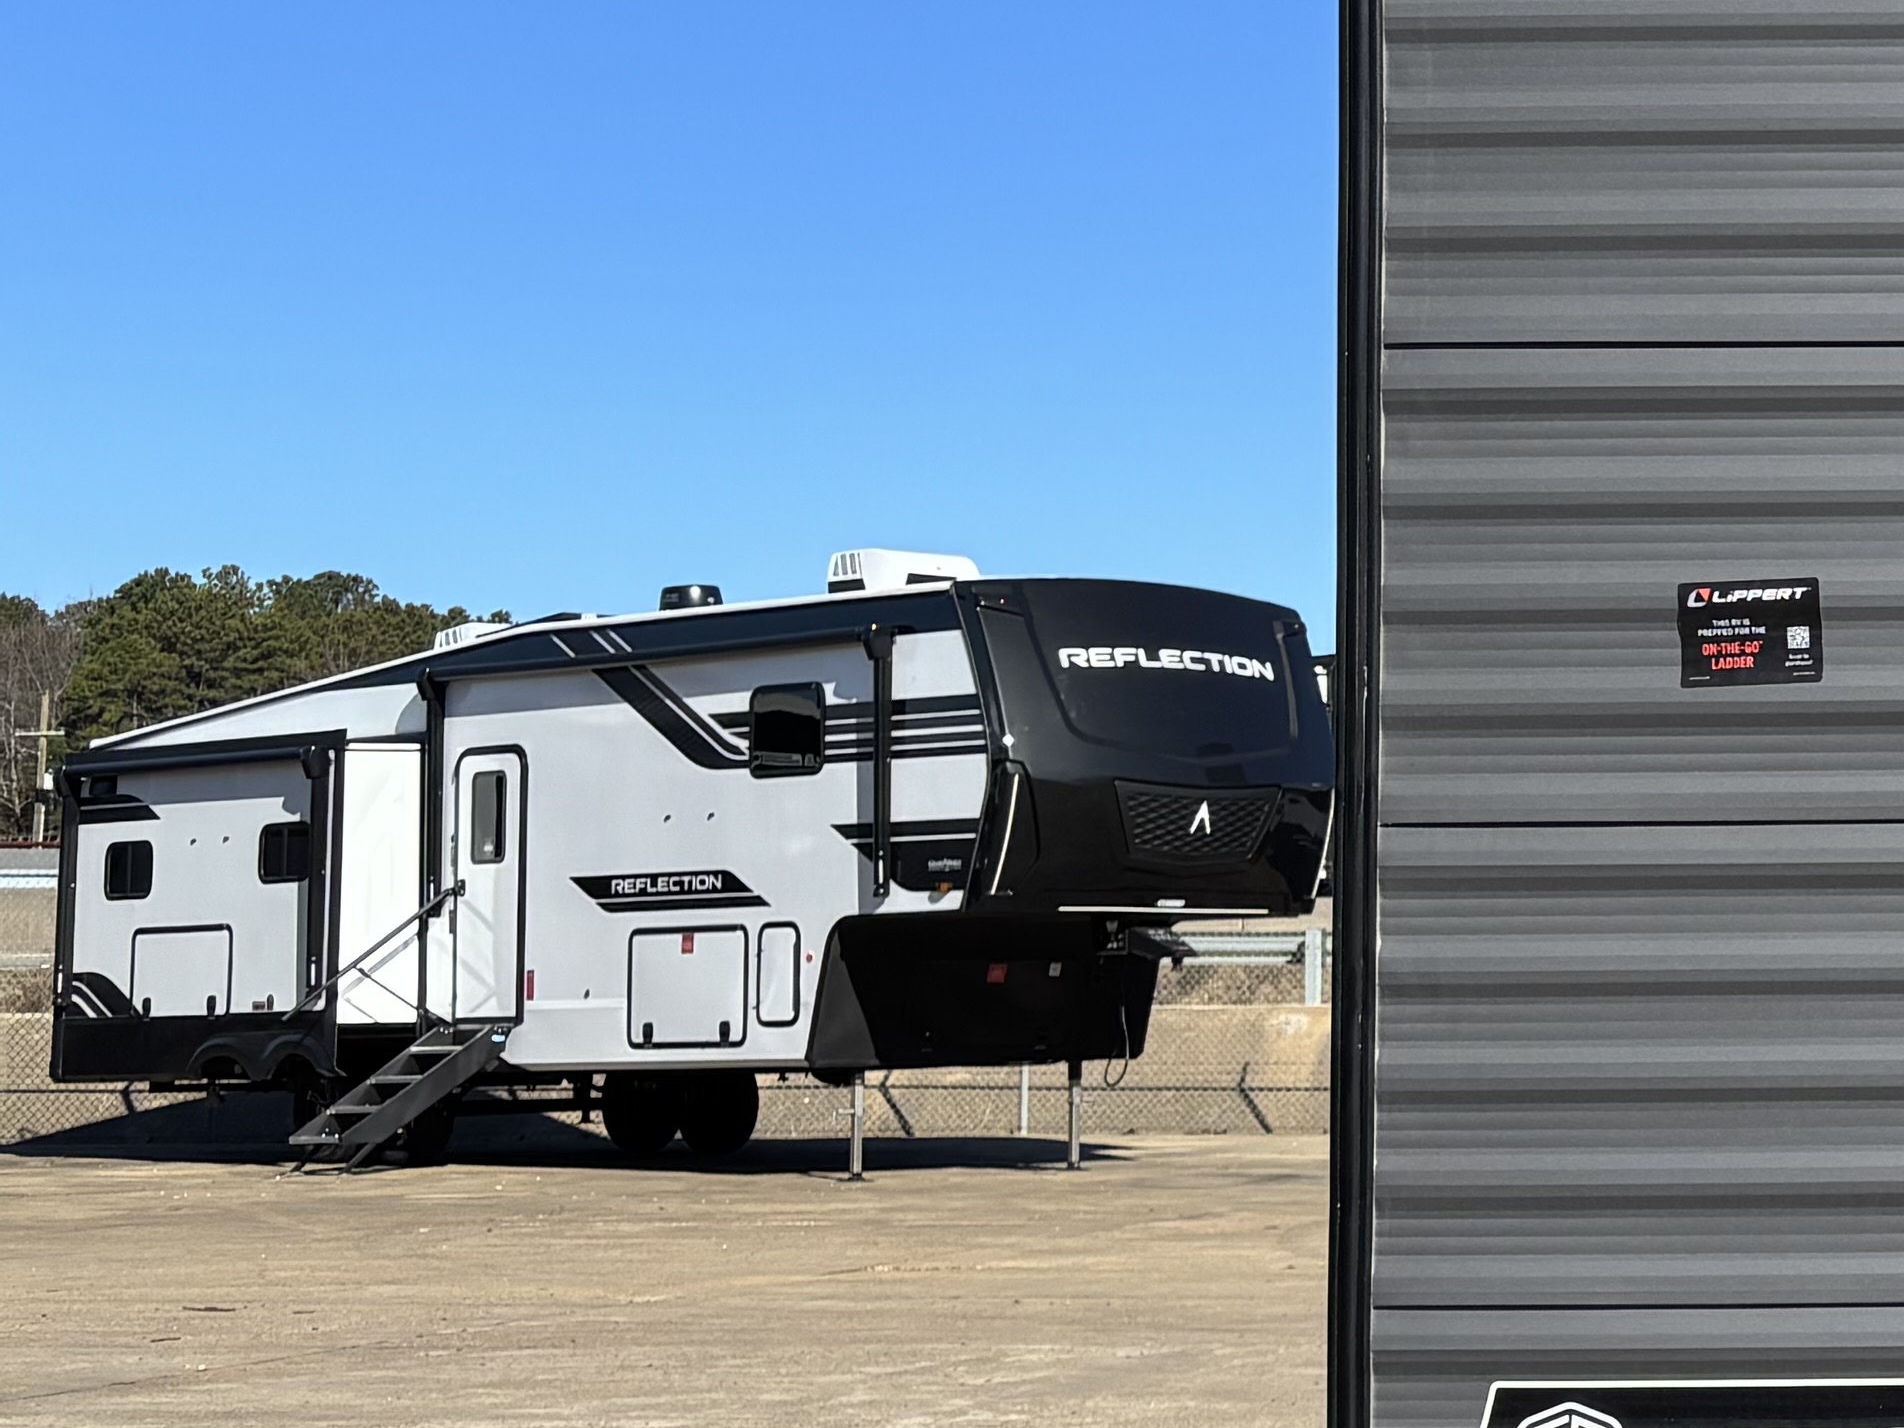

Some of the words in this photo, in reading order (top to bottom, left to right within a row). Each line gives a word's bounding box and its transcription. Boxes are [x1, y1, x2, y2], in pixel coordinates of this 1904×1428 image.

[1058, 647, 1275, 682] REFLECTION
[1711, 656, 1754, 670] LADDER
[611, 874, 722, 895] REFLECTION
